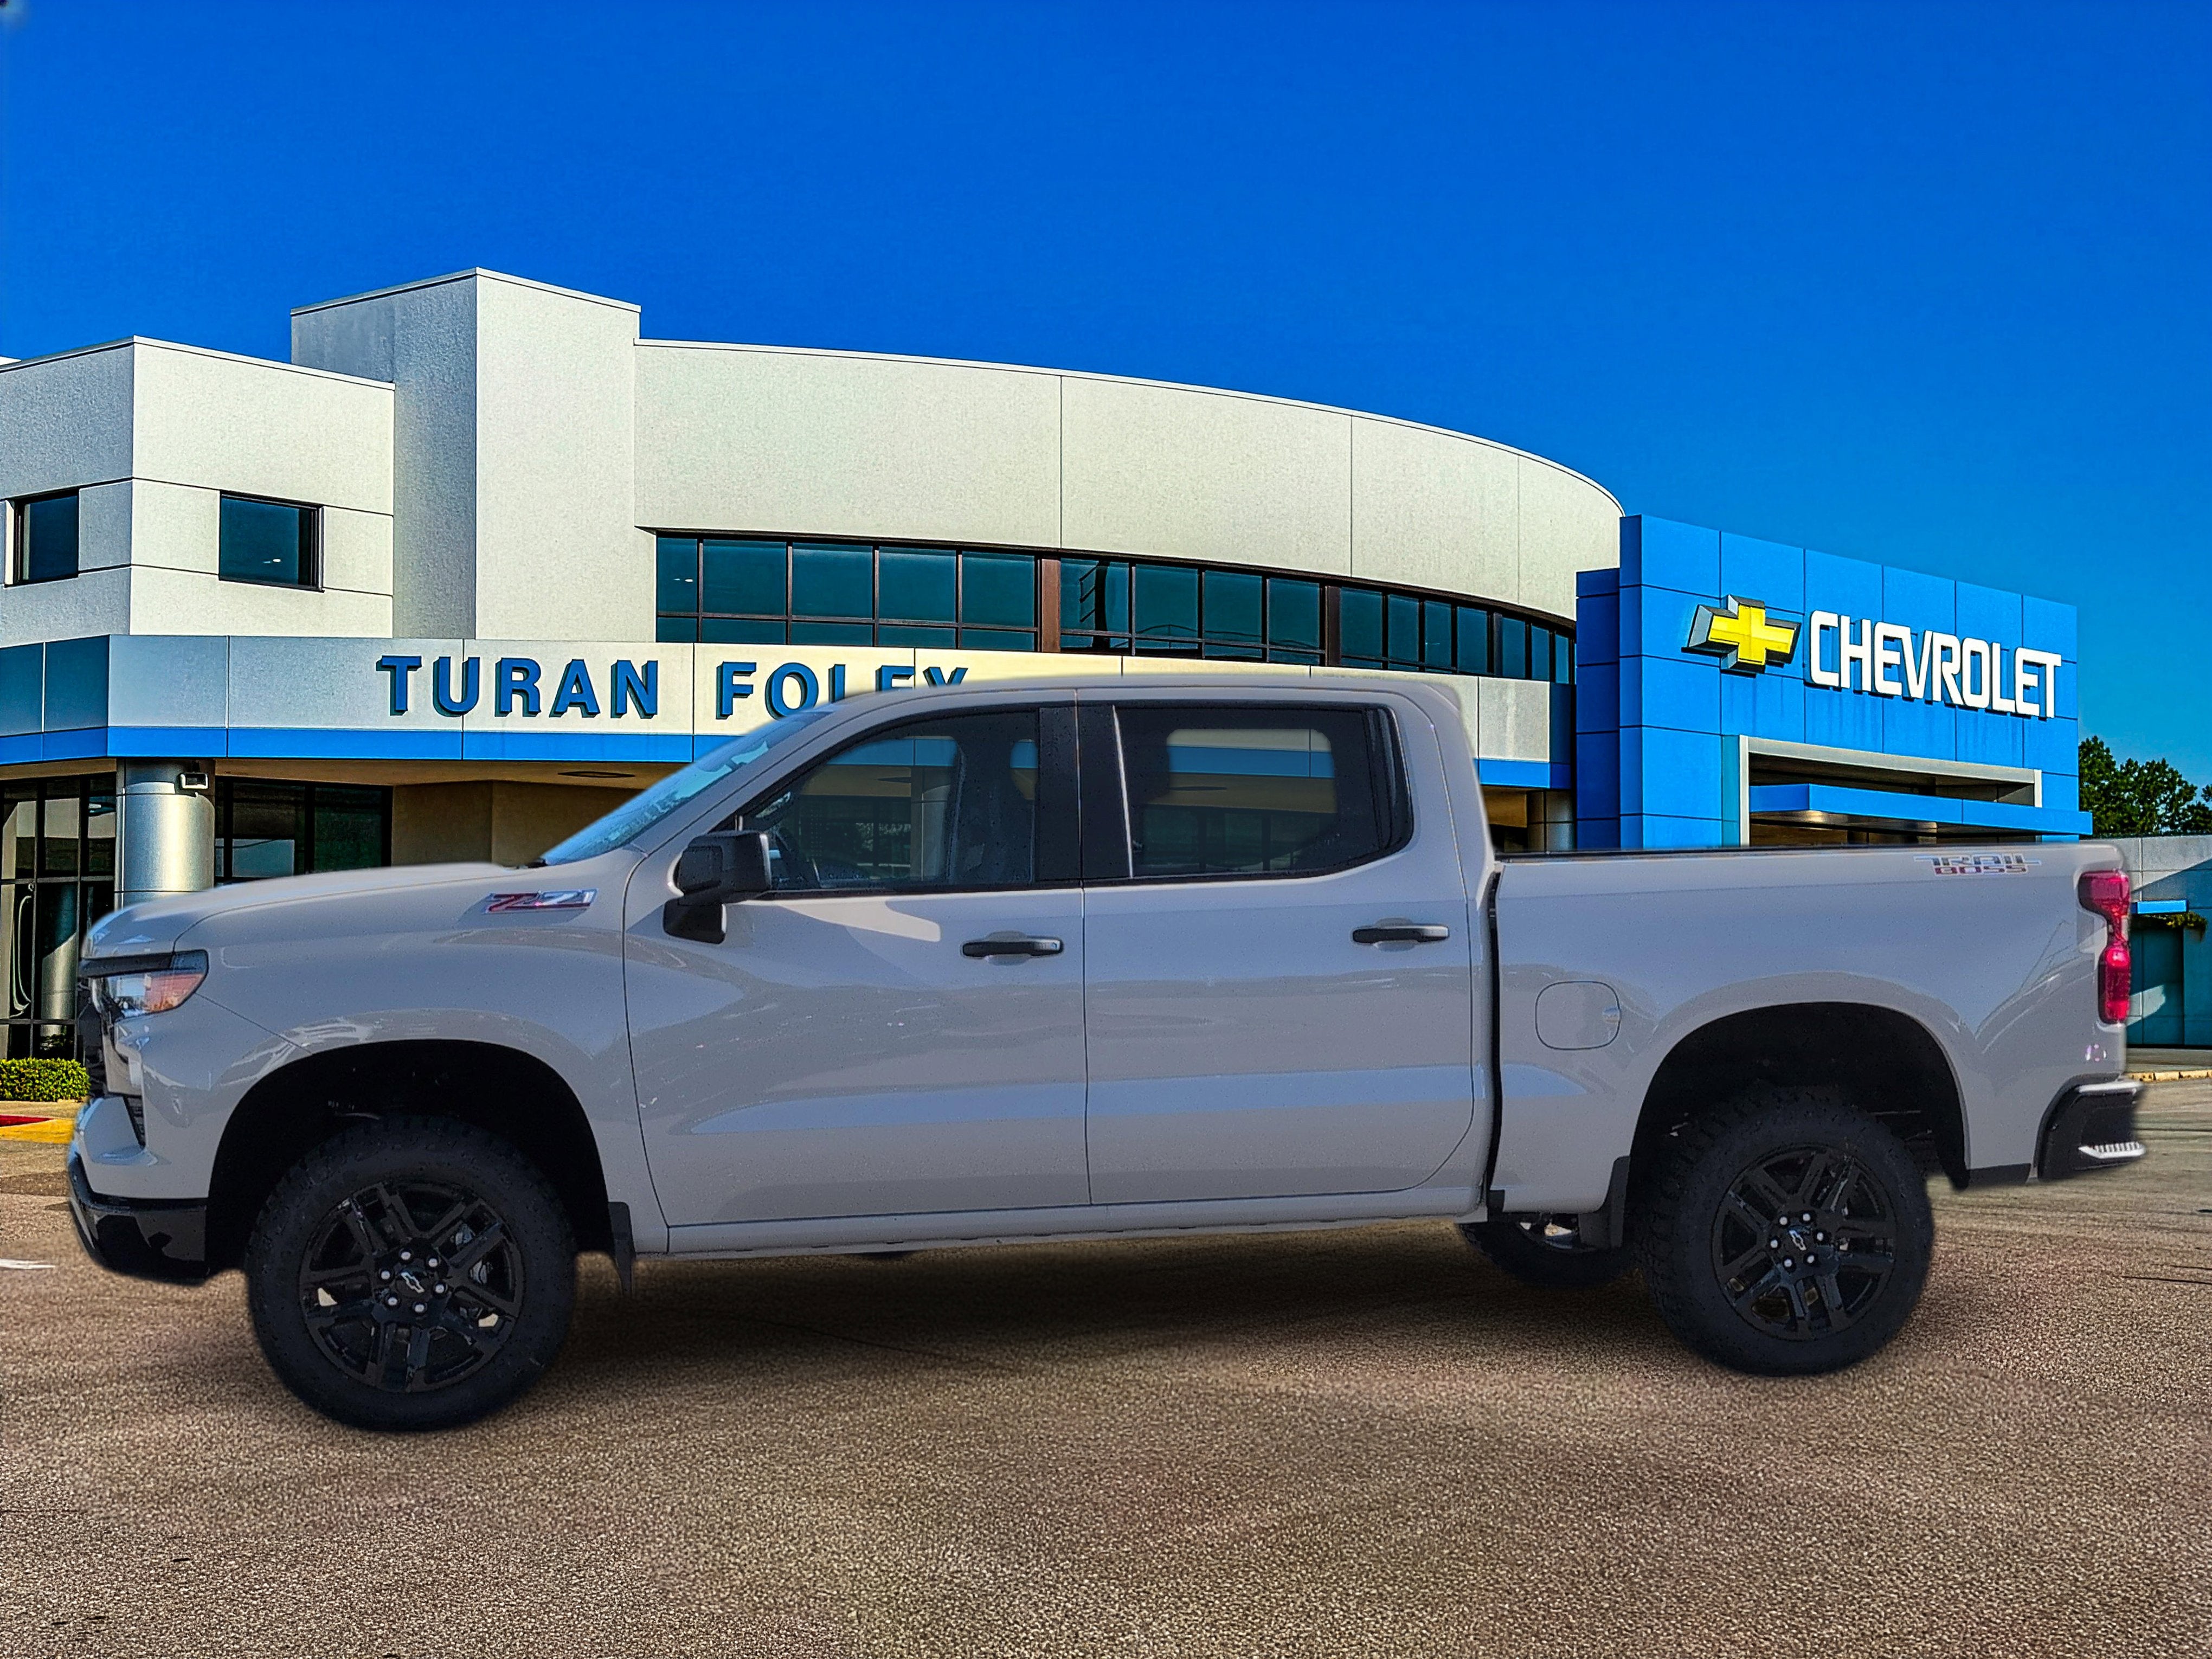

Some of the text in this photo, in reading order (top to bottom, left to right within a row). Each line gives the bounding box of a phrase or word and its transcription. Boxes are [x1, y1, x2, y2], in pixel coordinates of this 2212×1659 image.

[1809, 609, 2062, 718] CHEVROLET
[376, 655, 659, 719] TURAN
[1913, 853, 2042, 866] TRAIL
[1933, 865, 2029, 876] BOSS
[481, 888, 599, 915] Z71
